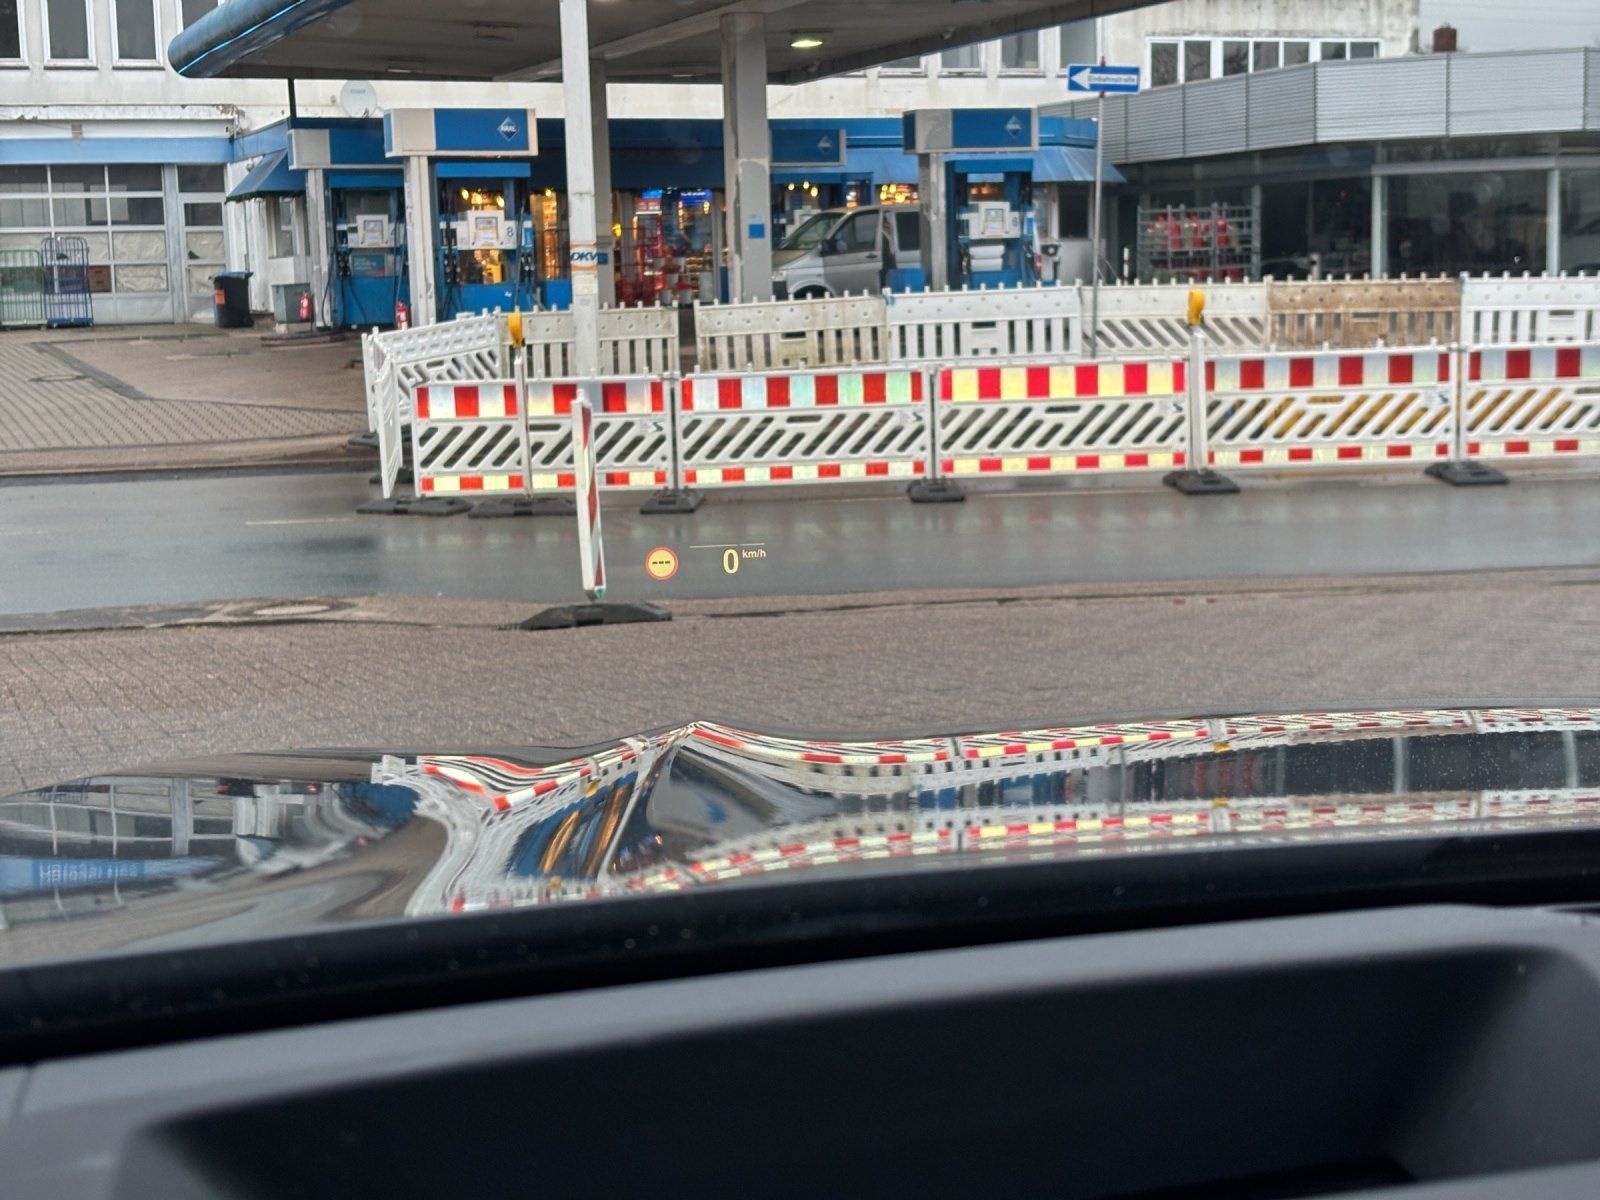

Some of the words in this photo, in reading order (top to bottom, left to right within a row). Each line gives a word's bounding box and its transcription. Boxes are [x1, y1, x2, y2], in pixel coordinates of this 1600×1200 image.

[506, 226, 514, 237] 8
[570, 251, 598, 262] DKV
[723, 549, 739, 574] 0
[742, 549, 766, 558] km/h
